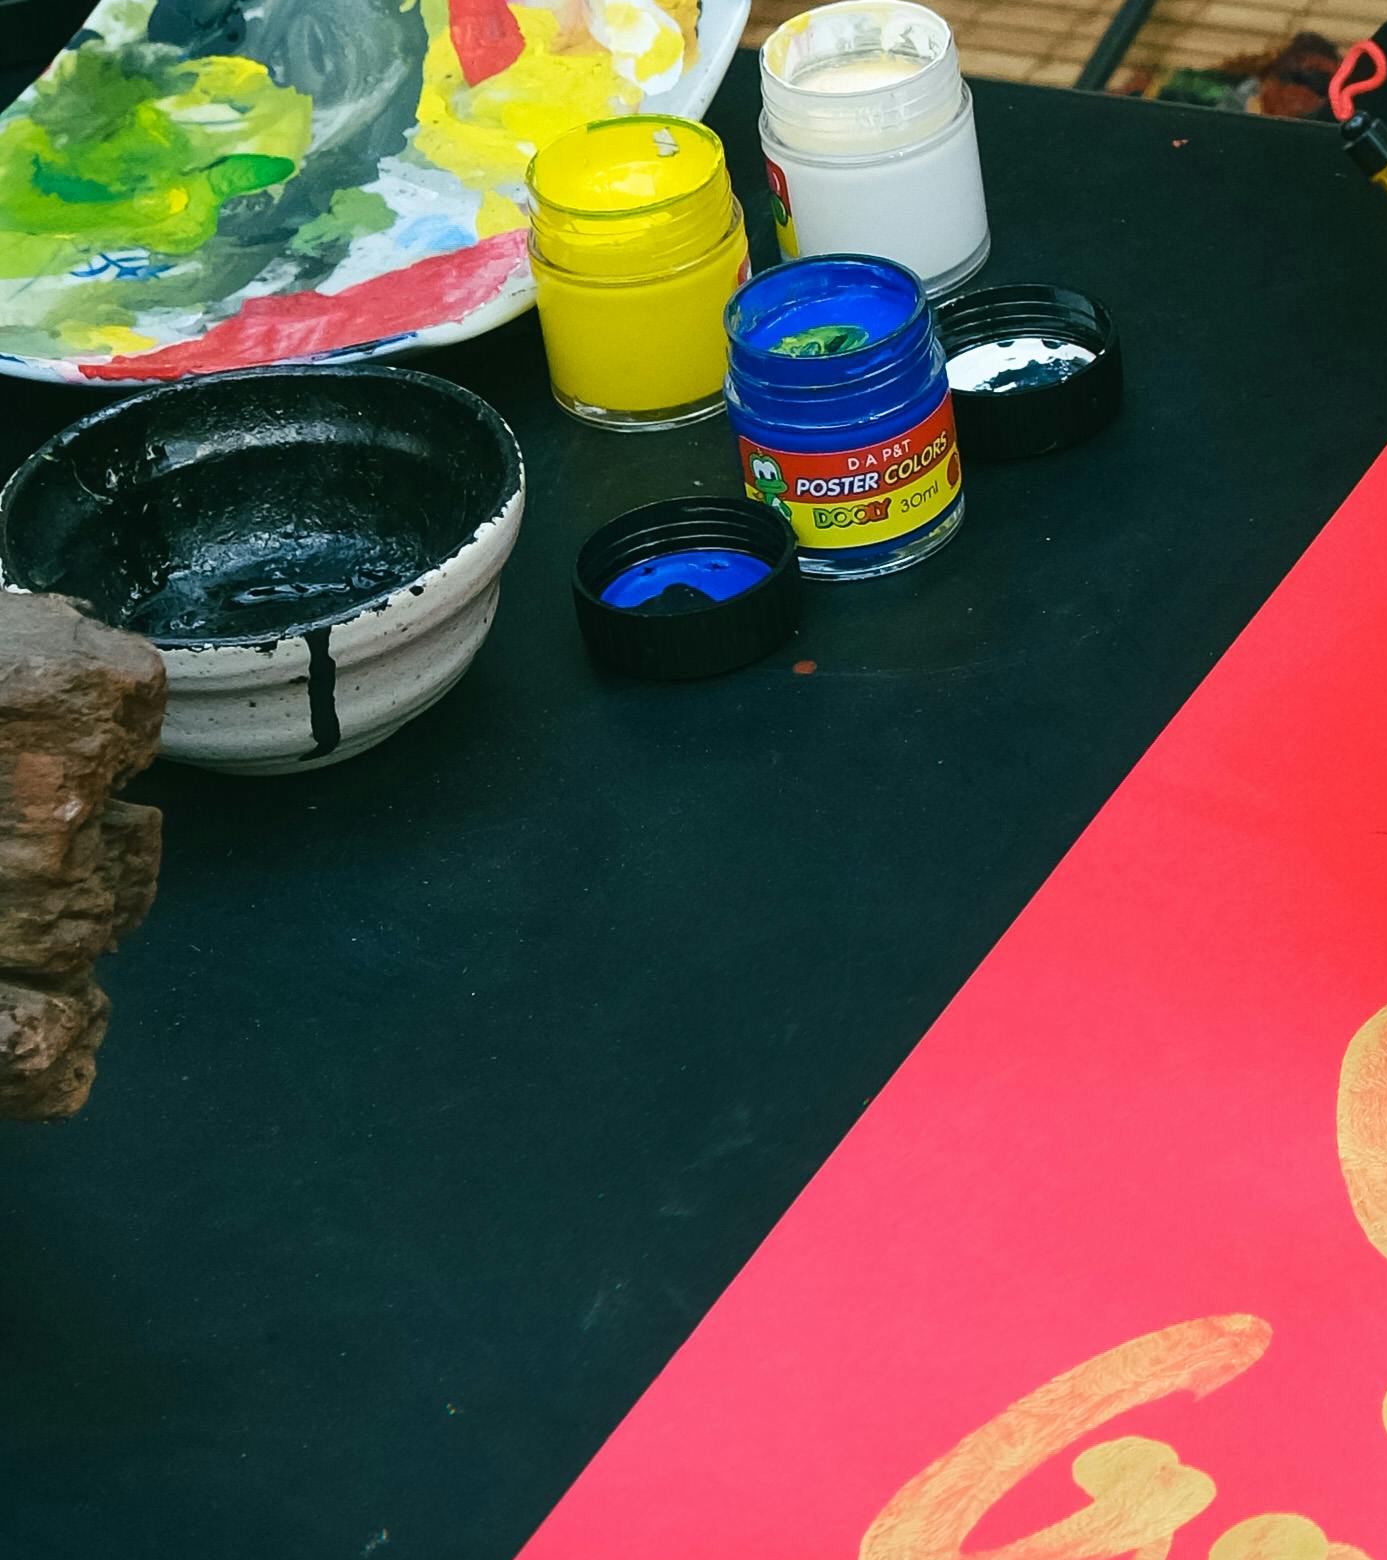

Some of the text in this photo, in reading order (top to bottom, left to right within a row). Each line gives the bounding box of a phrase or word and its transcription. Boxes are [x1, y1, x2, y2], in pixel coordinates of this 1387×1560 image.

[796, 431, 947, 497] POSTER COLORS
[900, 480, 940, 514] 30ml
